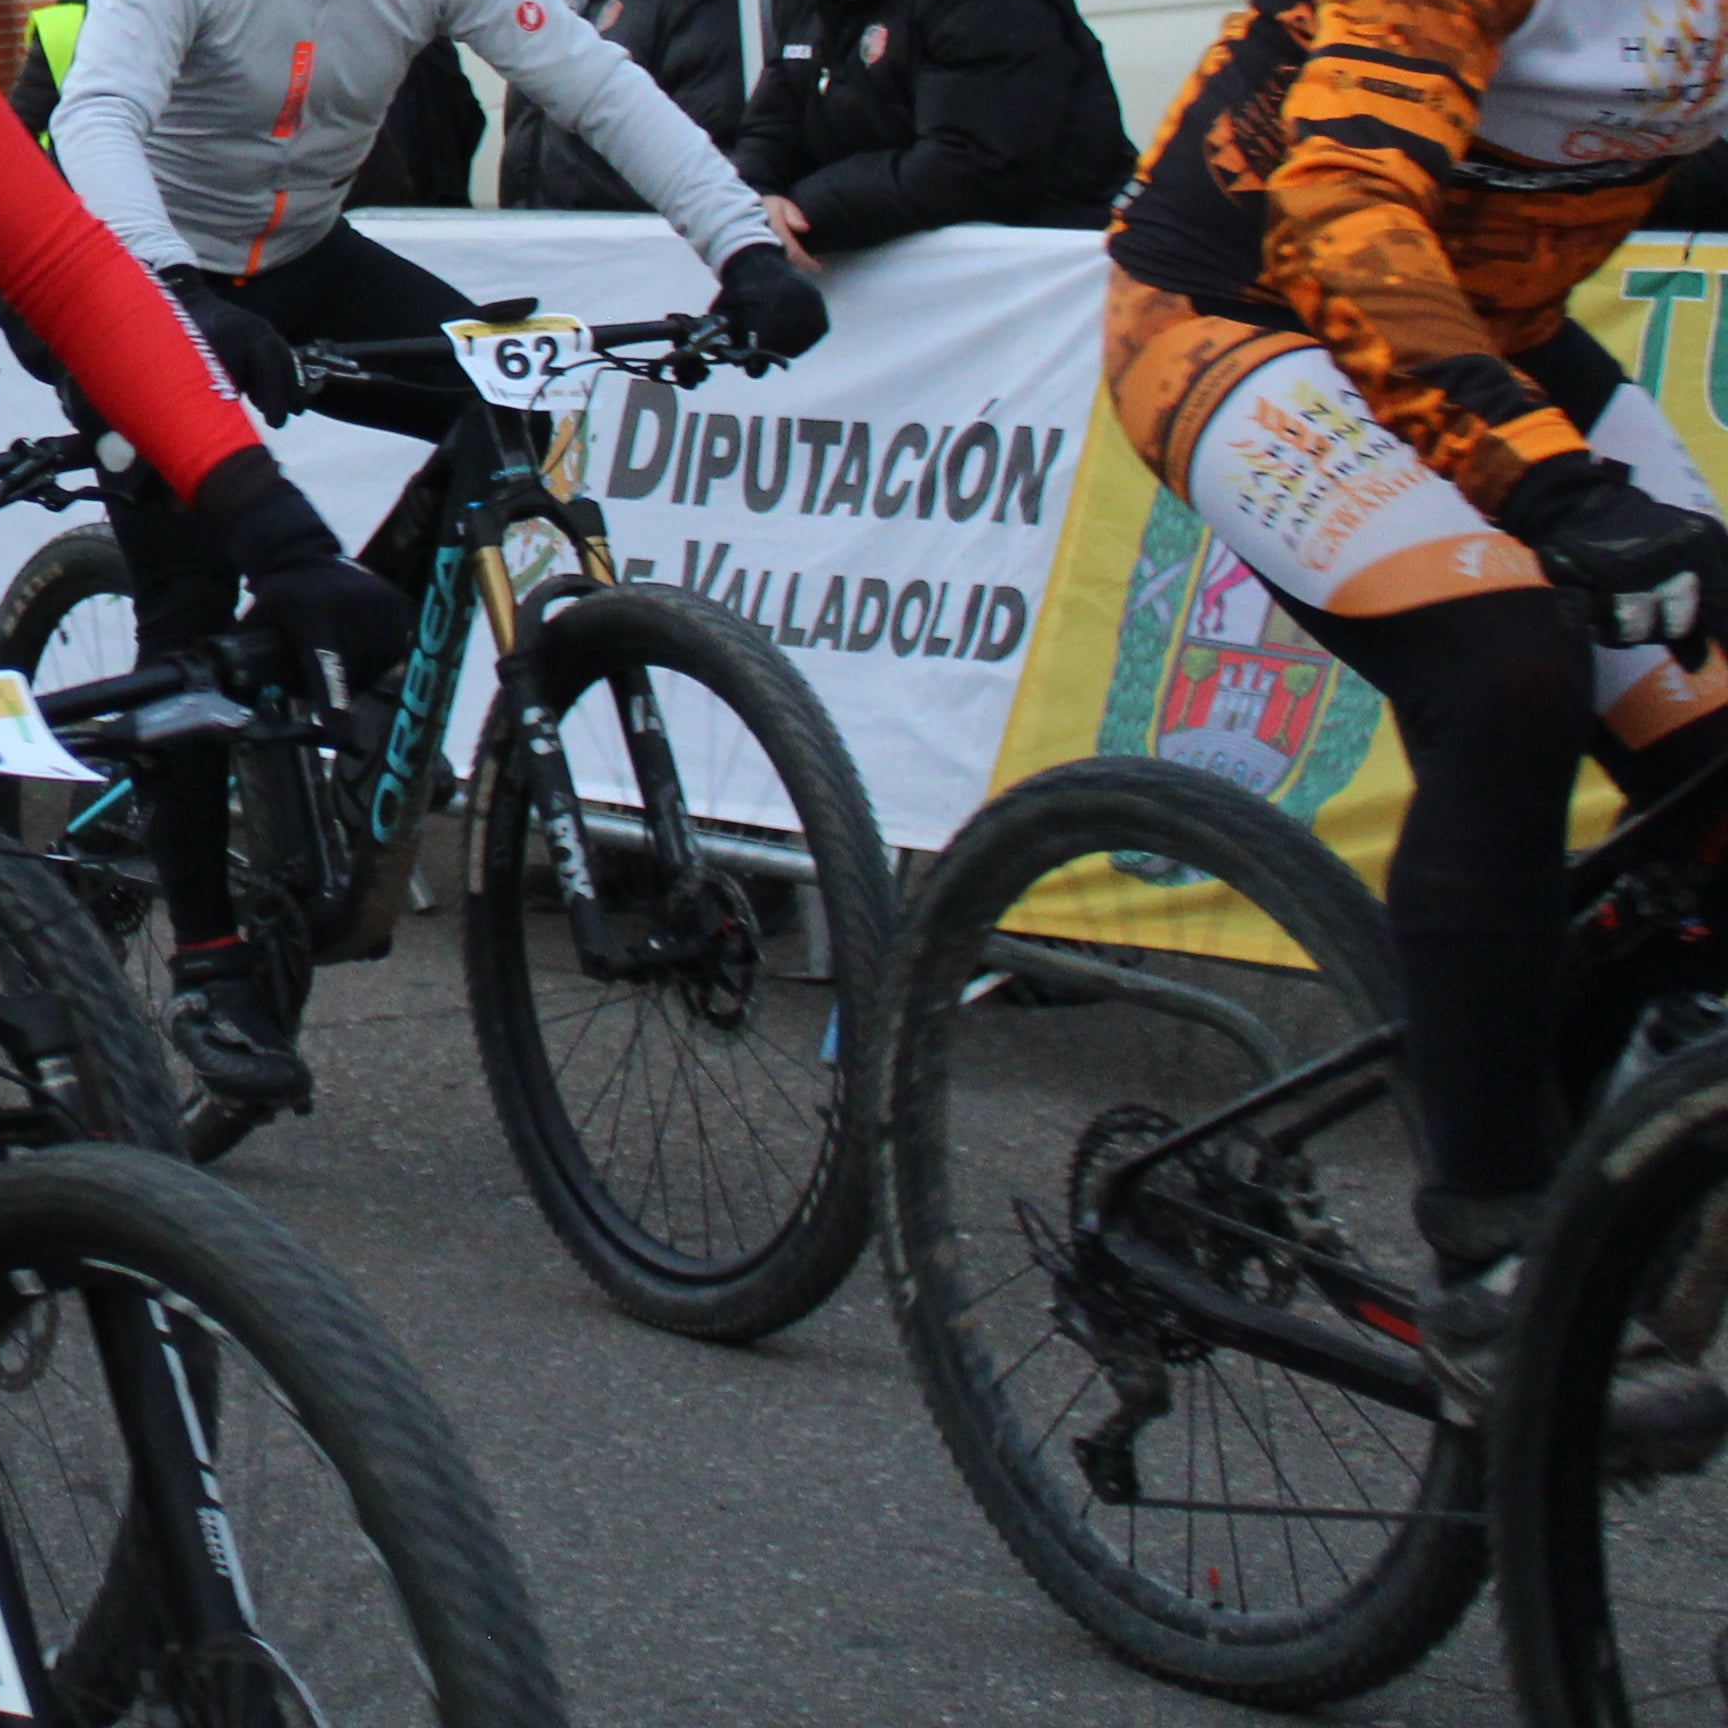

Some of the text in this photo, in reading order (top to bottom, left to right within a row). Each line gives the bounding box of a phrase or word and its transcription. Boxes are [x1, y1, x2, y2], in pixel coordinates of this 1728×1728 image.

[495, 335, 567, 381] 62
[606, 378, 1066, 526] DIPUTACIÓN
[371, 545, 467, 844] ORBEA
